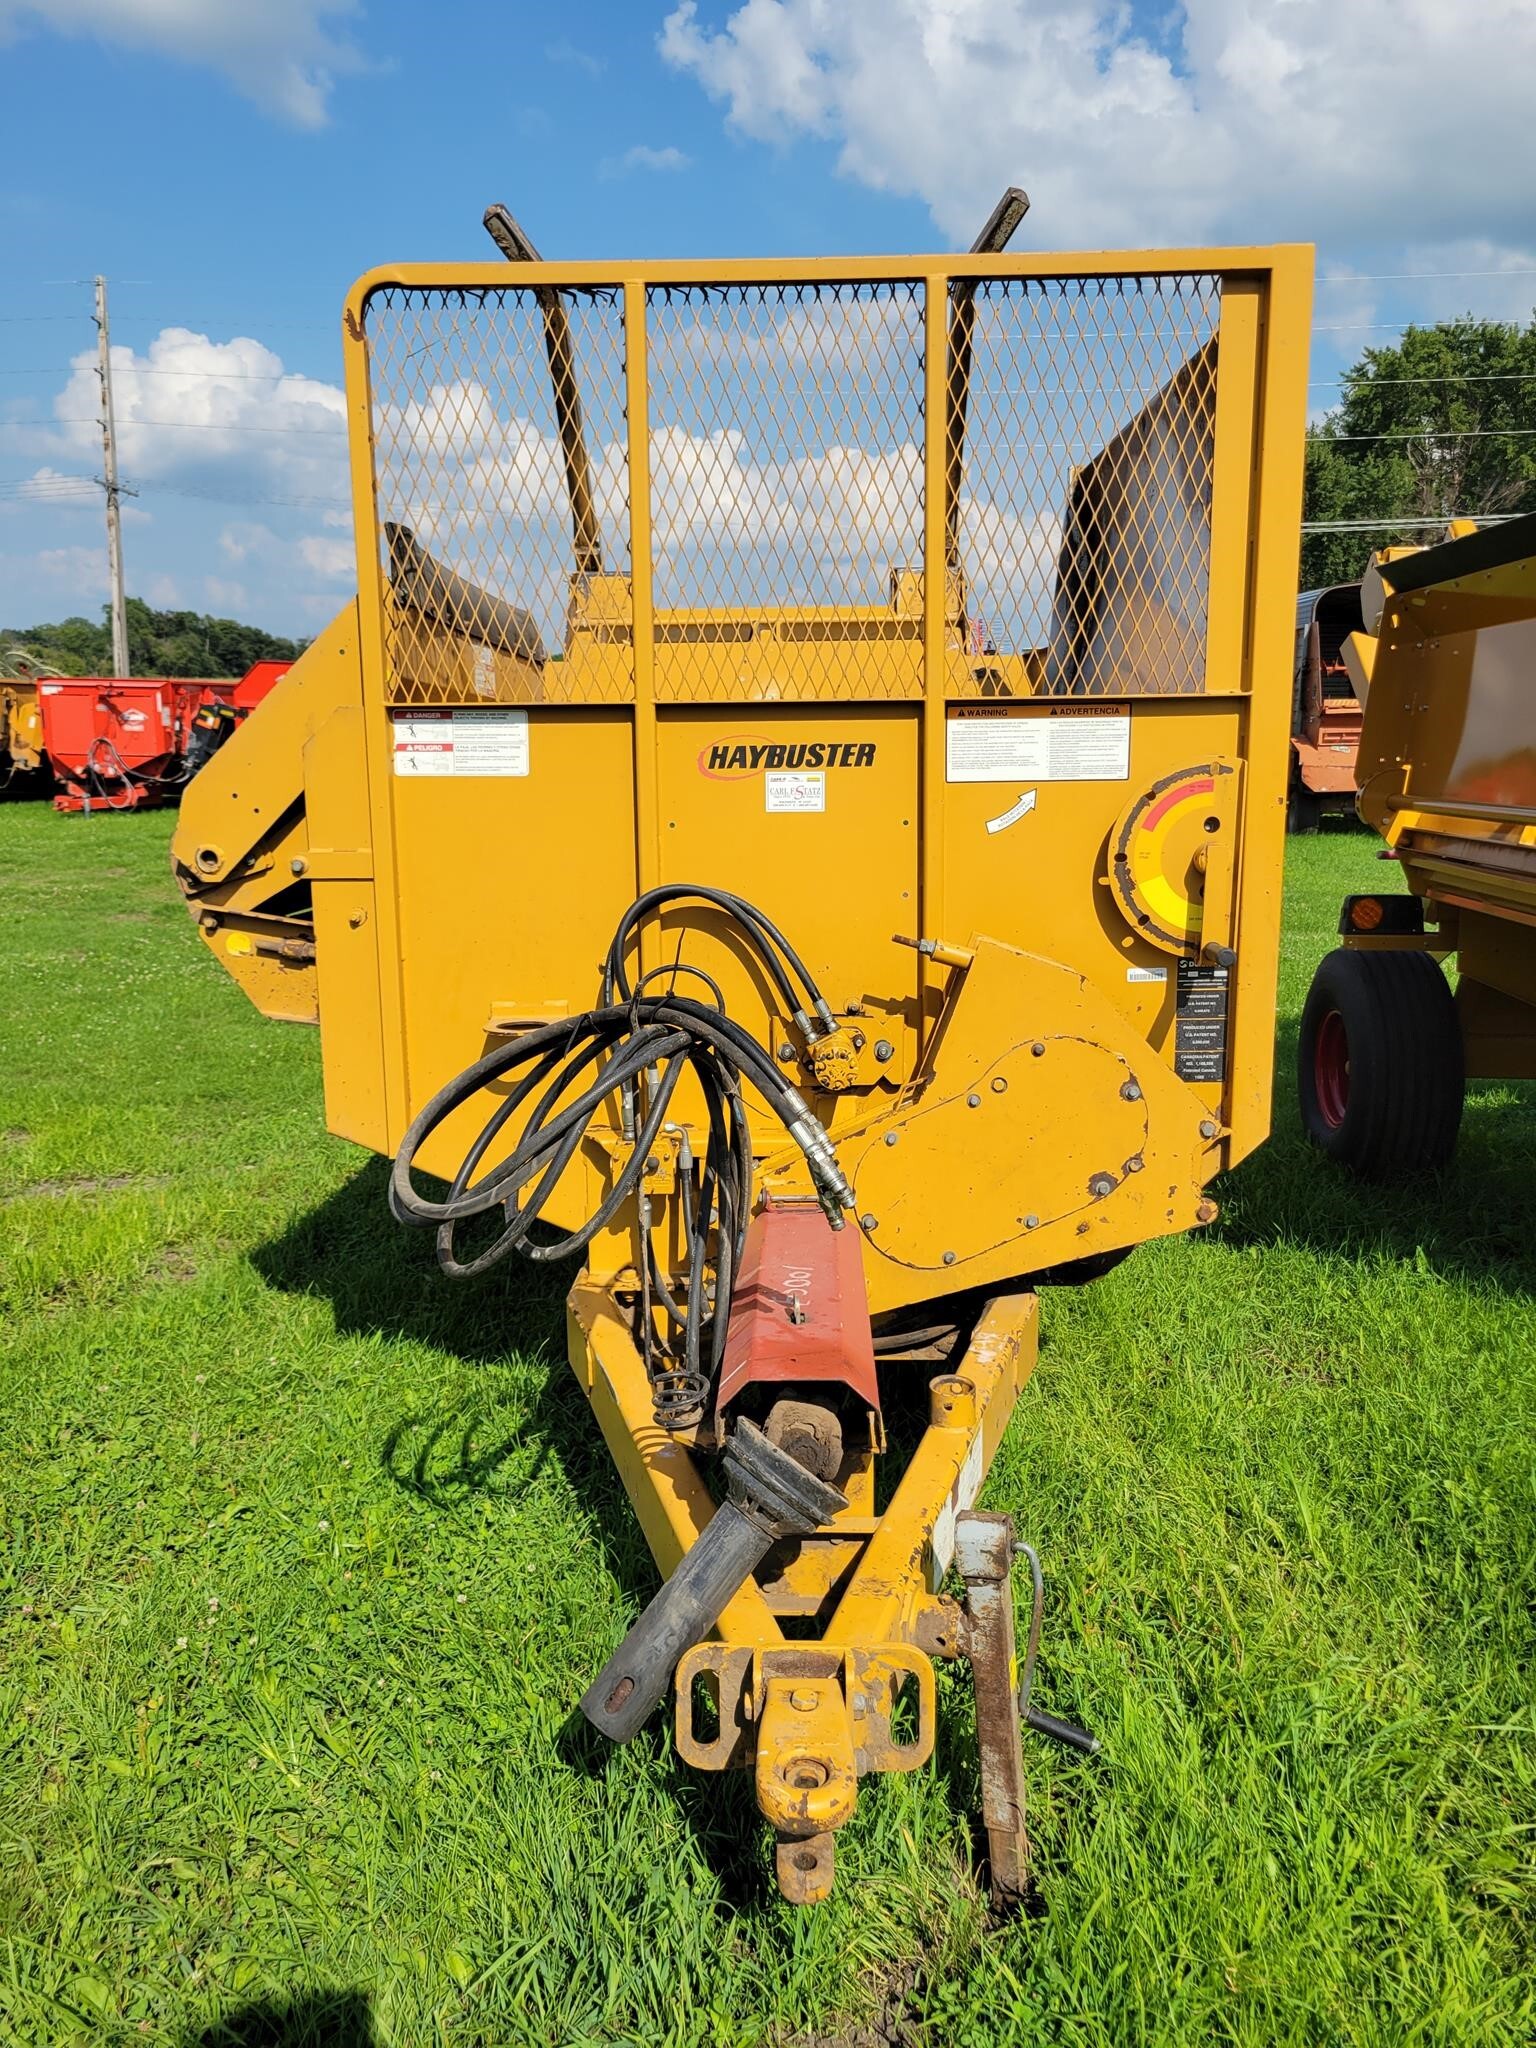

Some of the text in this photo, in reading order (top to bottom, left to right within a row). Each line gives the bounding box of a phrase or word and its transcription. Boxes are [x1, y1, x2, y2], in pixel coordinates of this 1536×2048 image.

[967, 709, 1008, 717] WARNING
[1059, 707, 1121, 715] ADVERTENCIA
[708, 743, 877, 769] HAYBUSTER
